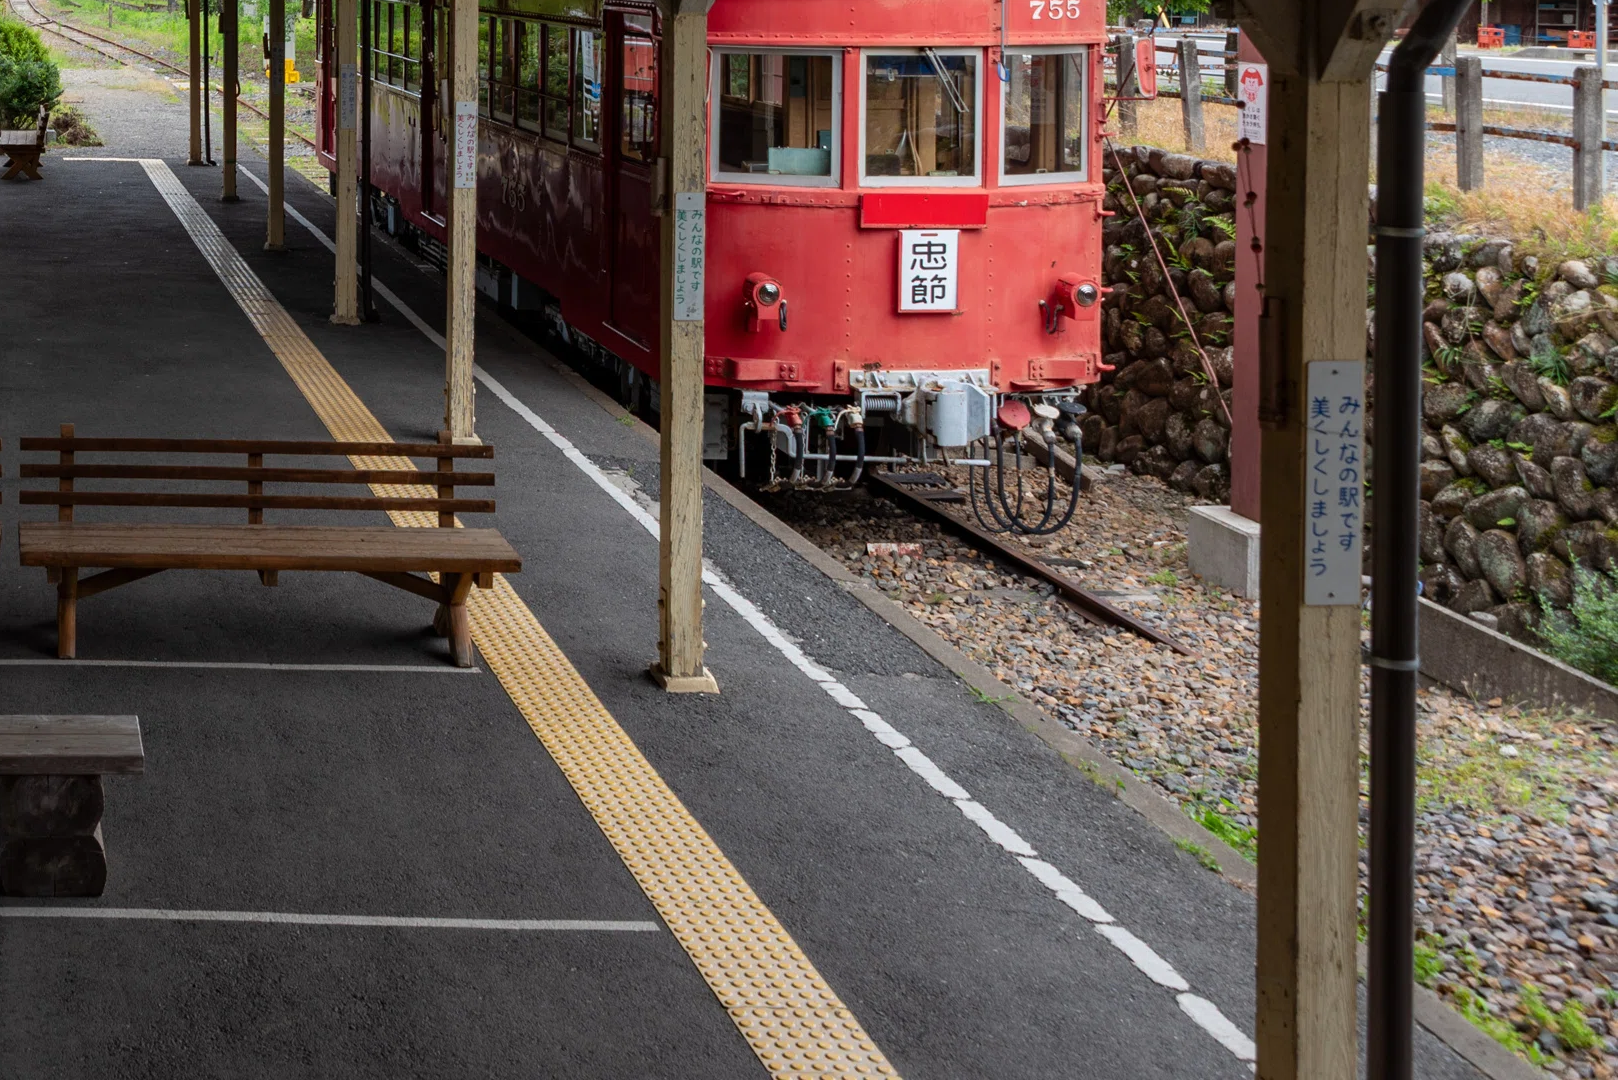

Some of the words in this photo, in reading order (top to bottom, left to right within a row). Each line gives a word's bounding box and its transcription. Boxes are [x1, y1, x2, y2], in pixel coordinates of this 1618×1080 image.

[1029, 0, 1081, 20] 755
[466, 113, 476, 169] みんなの駅です
[675, 210, 687, 304] 美くしくしましょう
[690, 209, 703, 292] みんなの駅です
[910, 240, 947, 304] 忠節
[1310, 396, 1331, 577] 美くしくしましょう
[1338, 396, 1360, 552] みんなの駅です
